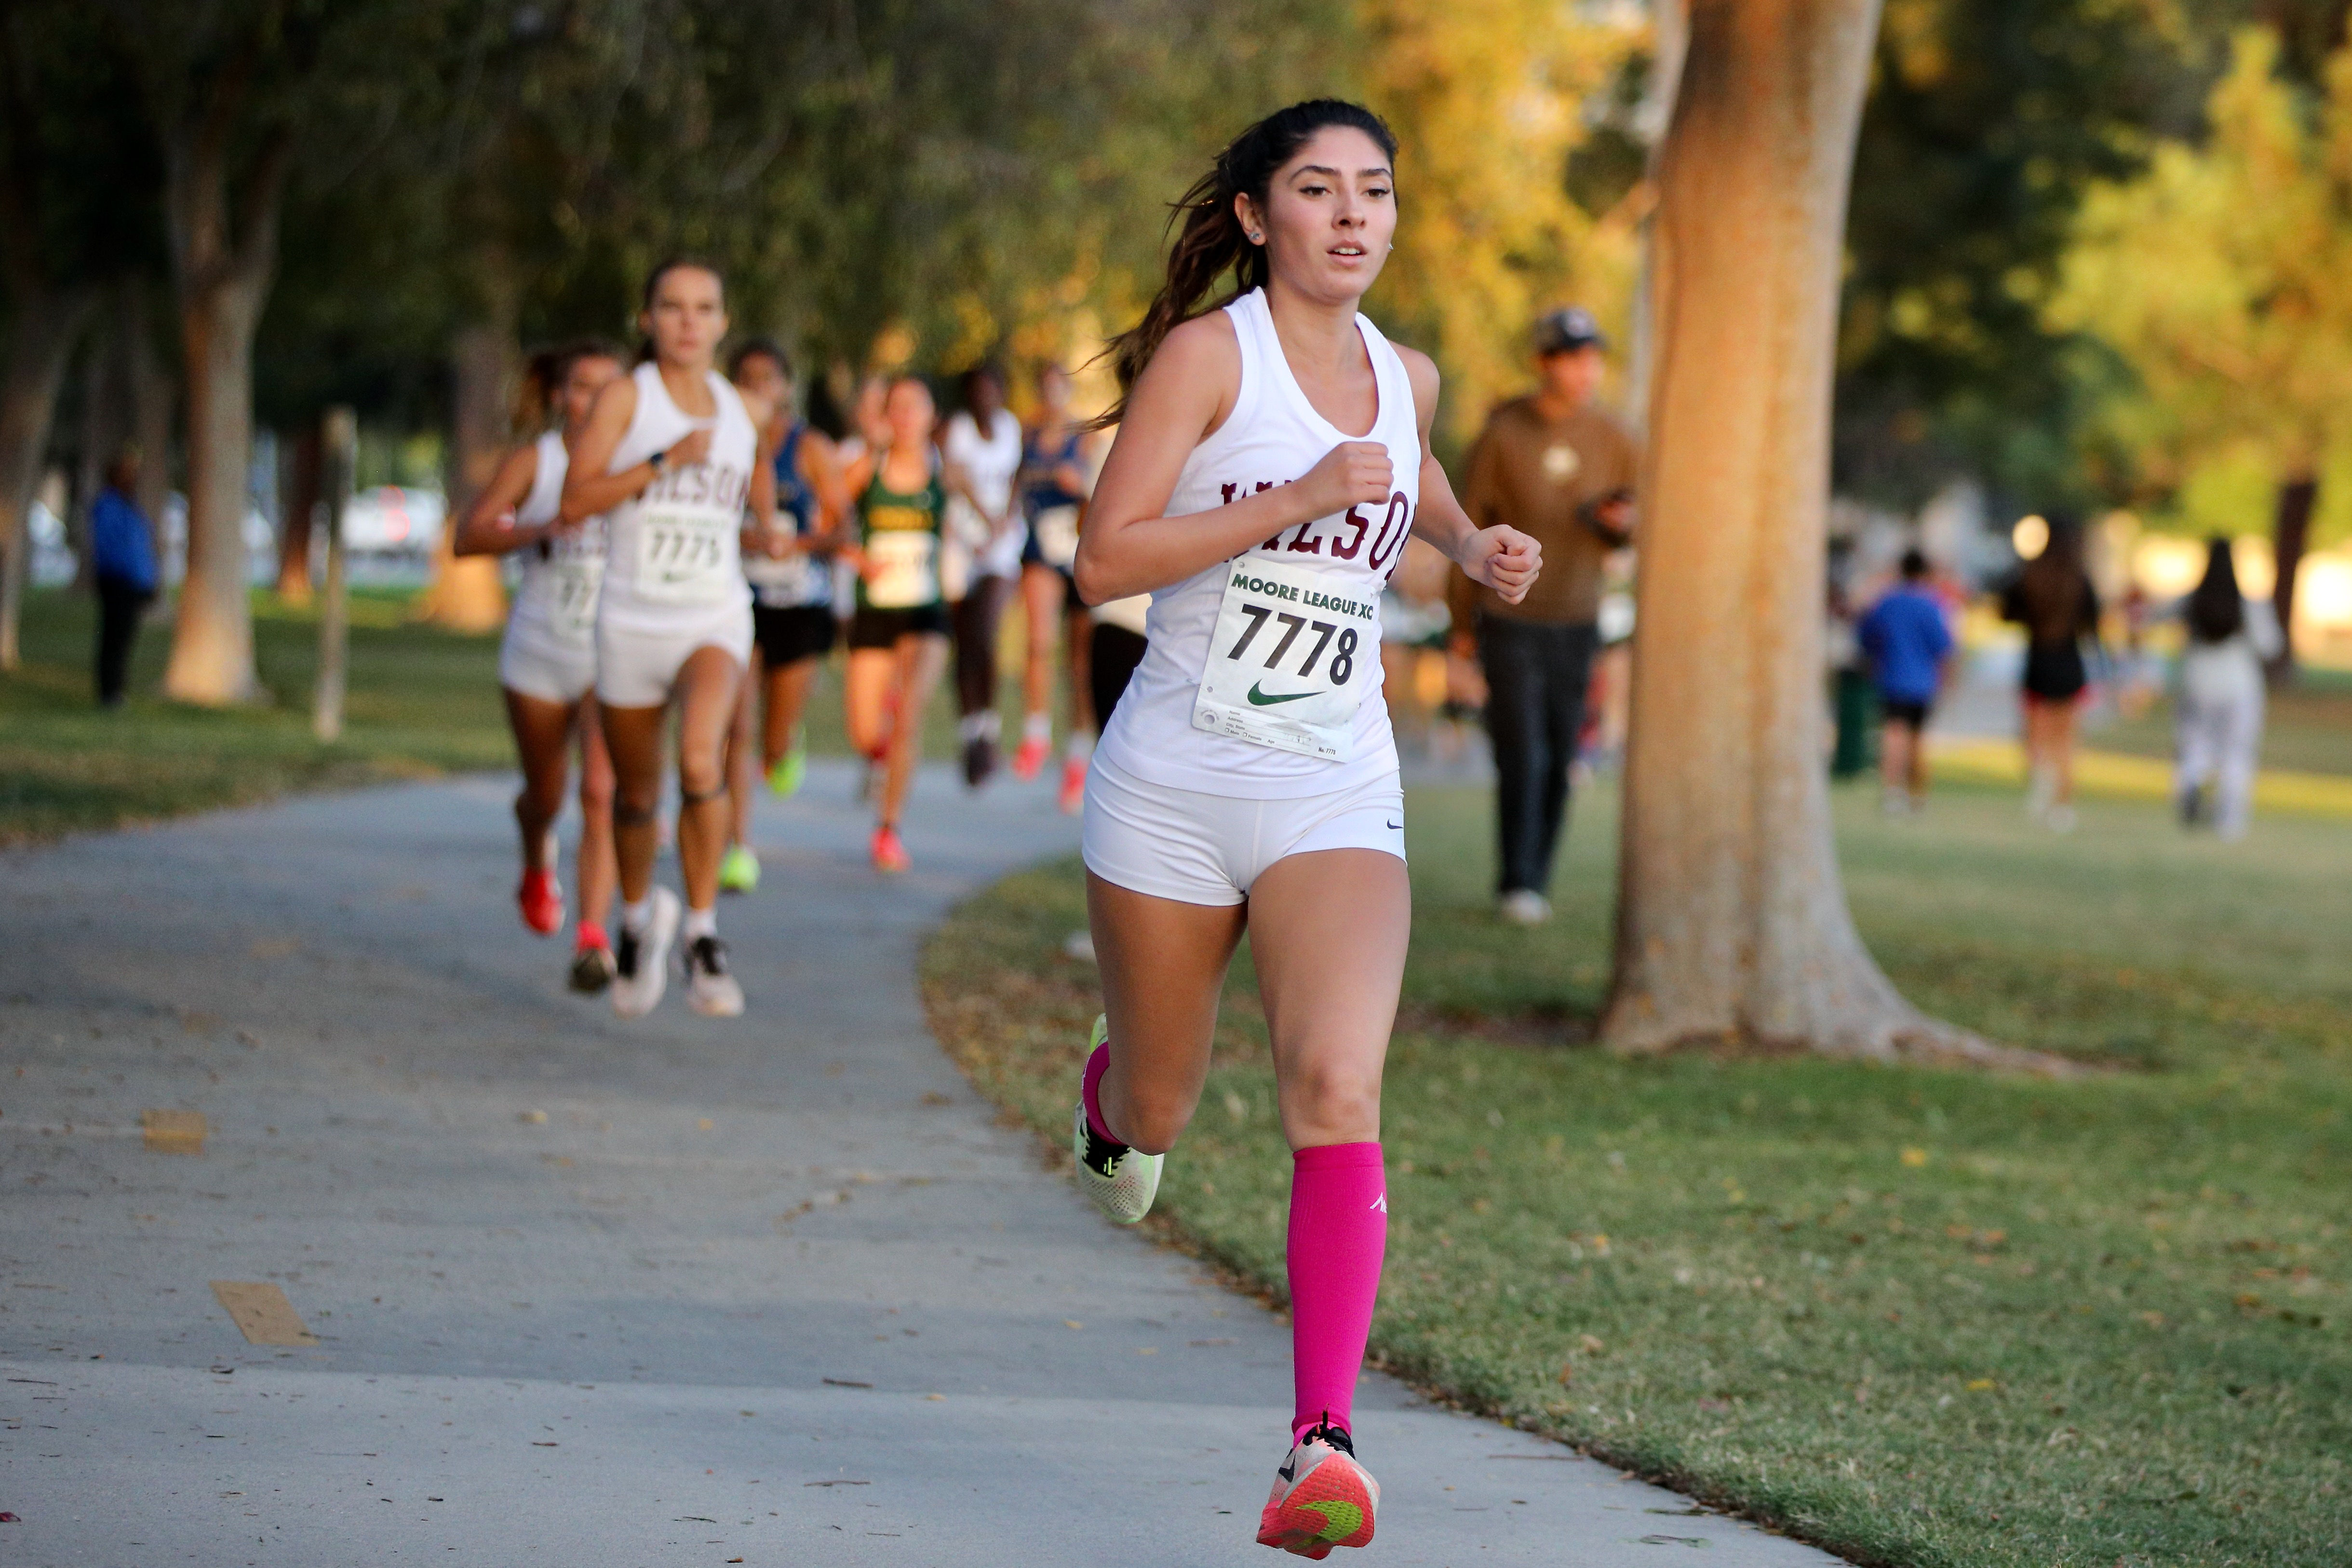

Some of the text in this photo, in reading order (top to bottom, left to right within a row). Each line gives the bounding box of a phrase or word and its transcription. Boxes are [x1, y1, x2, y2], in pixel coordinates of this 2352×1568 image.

[1231, 573, 1373, 620] MOORE LEAGUE XC
[1227, 603, 1358, 686] 7778
